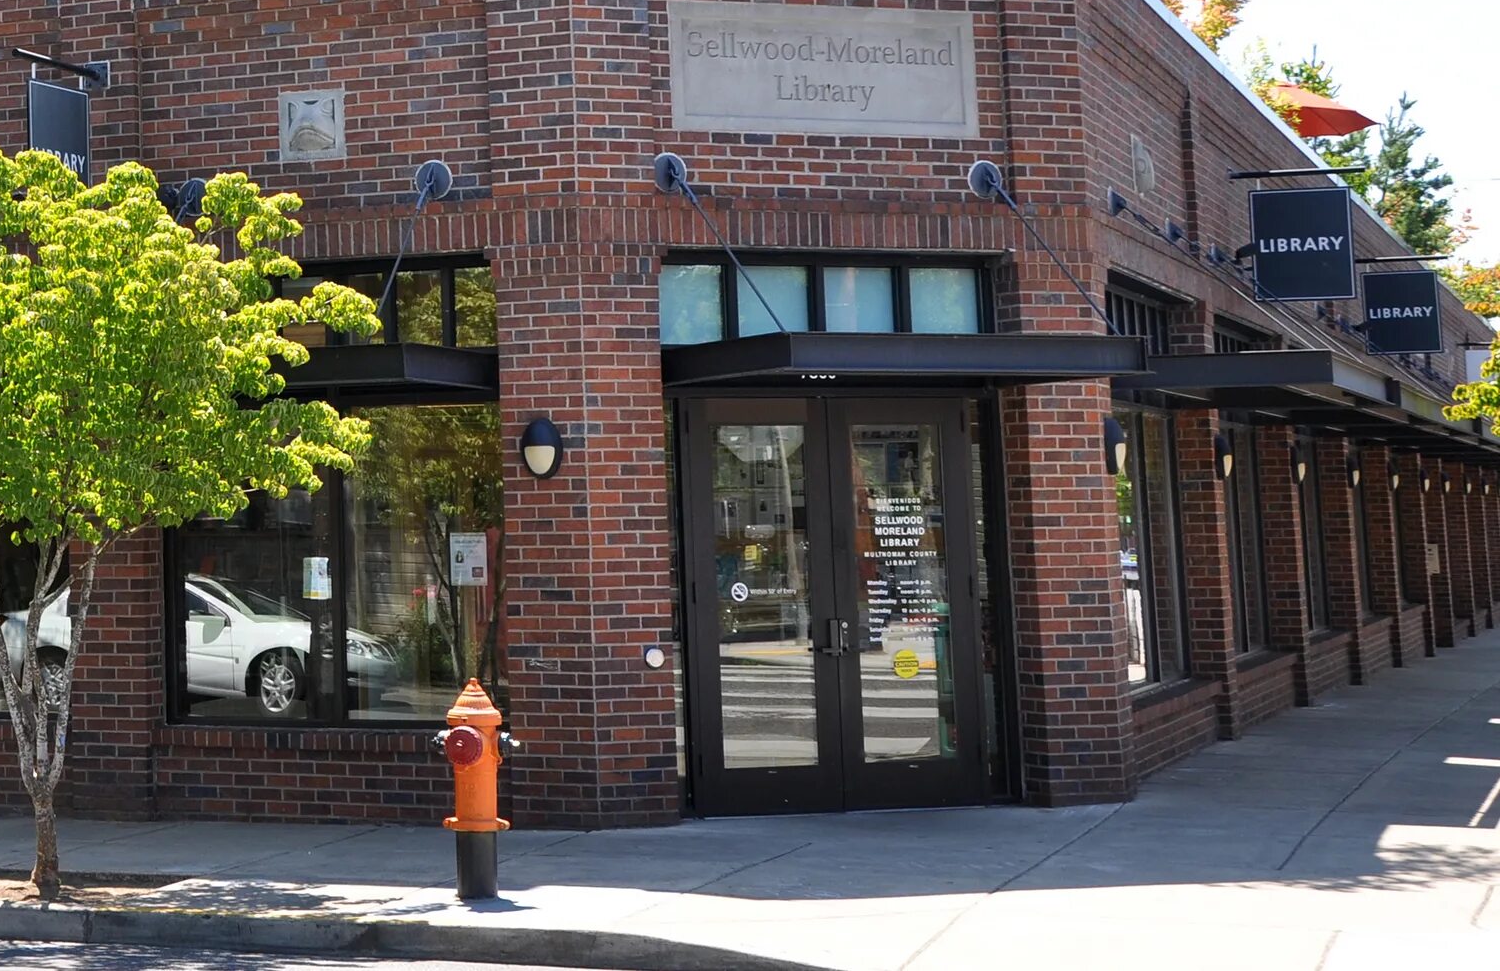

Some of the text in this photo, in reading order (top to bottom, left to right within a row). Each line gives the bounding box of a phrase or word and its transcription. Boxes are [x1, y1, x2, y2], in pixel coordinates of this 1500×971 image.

[687, 31, 955, 66] Sellwood-Moreland
[775, 75, 875, 112] Library
[35, 146, 85, 173] RARY
[1260, 236, 1344, 253] LIBRARY
[1369, 306, 1433, 319] LIBRARY
[875, 516, 923, 524] SELLWOOD
[875, 527, 925, 535] MORELAND
[880, 538, 920, 546] LIBRARY
